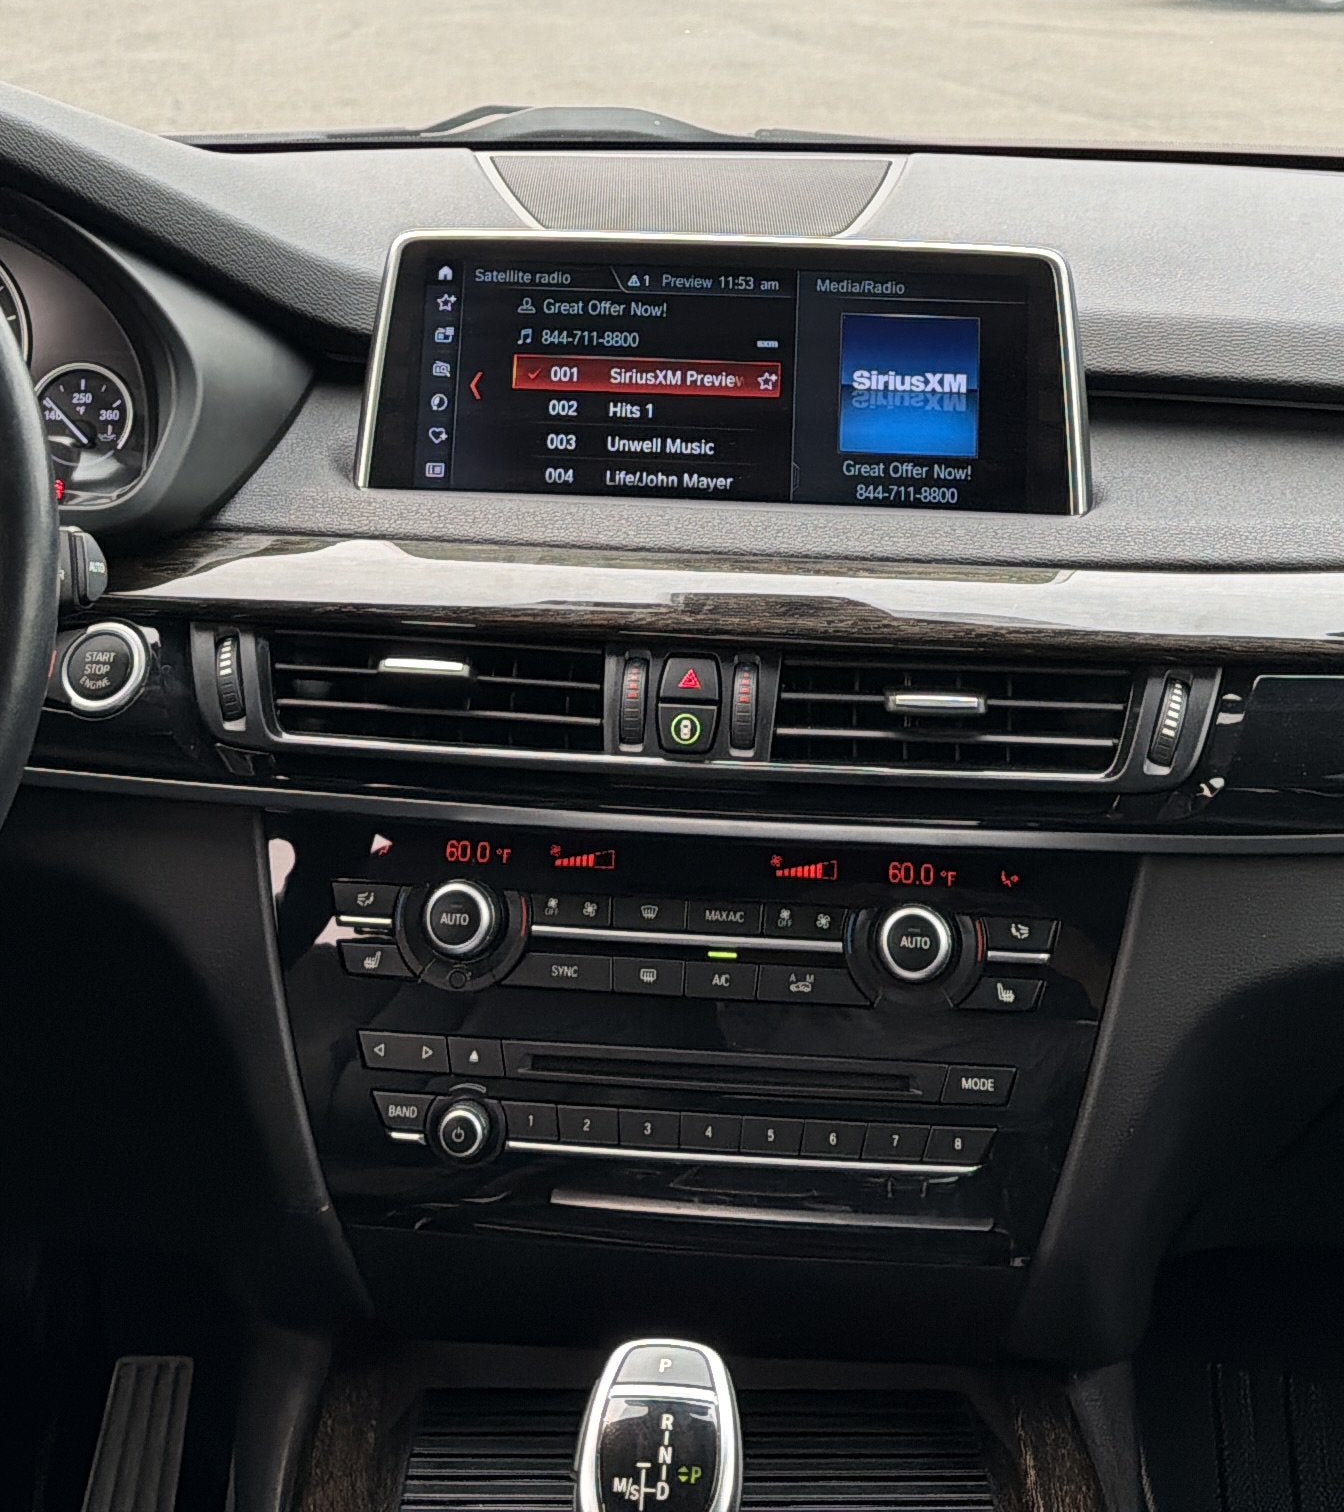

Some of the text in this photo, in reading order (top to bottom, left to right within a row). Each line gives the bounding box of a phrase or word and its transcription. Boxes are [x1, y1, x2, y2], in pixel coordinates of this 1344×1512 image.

[475, 268, 571, 285] Satellite radio
[643, 274, 779, 291] 1 Preview 11:53 am
[816, 279, 905, 295] Media/Radio
[543, 300, 667, 318] Great Offer Now!
[541, 330, 639, 348] 844-711-8800
[551, 366, 578, 383] 001
[609, 368, 682, 386] SiriusXM
[852, 370, 967, 394] SiriusXM
[72, 393, 93, 403] 250
[99, 409, 120, 420] 360
[548, 399, 654, 418] 002 Hits 1
[546, 434, 715, 455] 003 Unwell Music
[842, 460, 972, 480] Great Offer Now!
[545, 468, 734, 492] 004 Life/John Mayer
[856, 485, 958, 503] 844-711-8800
[85, 651, 116, 663] START
[84, 663, 110, 675] STOP
[79, 675, 111, 690] ENGINE
[445, 840, 491, 863] 60.0
[889, 861, 956, 886] 60.0 °F
[440, 912, 470, 927] AUTO
[544, 906, 559, 917] OFF
[778, 918, 793, 927] OFF
[899, 935, 931, 950] AUTO
[551, 965, 578, 978] SYNC
[789, 973, 815, 983] A M
[712, 973, 730, 987] A/C
[961, 1077, 995, 1091] MODE
[388, 1104, 418, 1119] BAND
[527, 1115, 962, 1150] 1 2 3 4 5 6 7 8
[659, 1358, 672, 1373] P
[661, 1414, 674, 1430] R
[659, 1446, 672, 1464] N
[691, 1467, 702, 1484] P
[612, 1477, 670, 1501] M/S D
